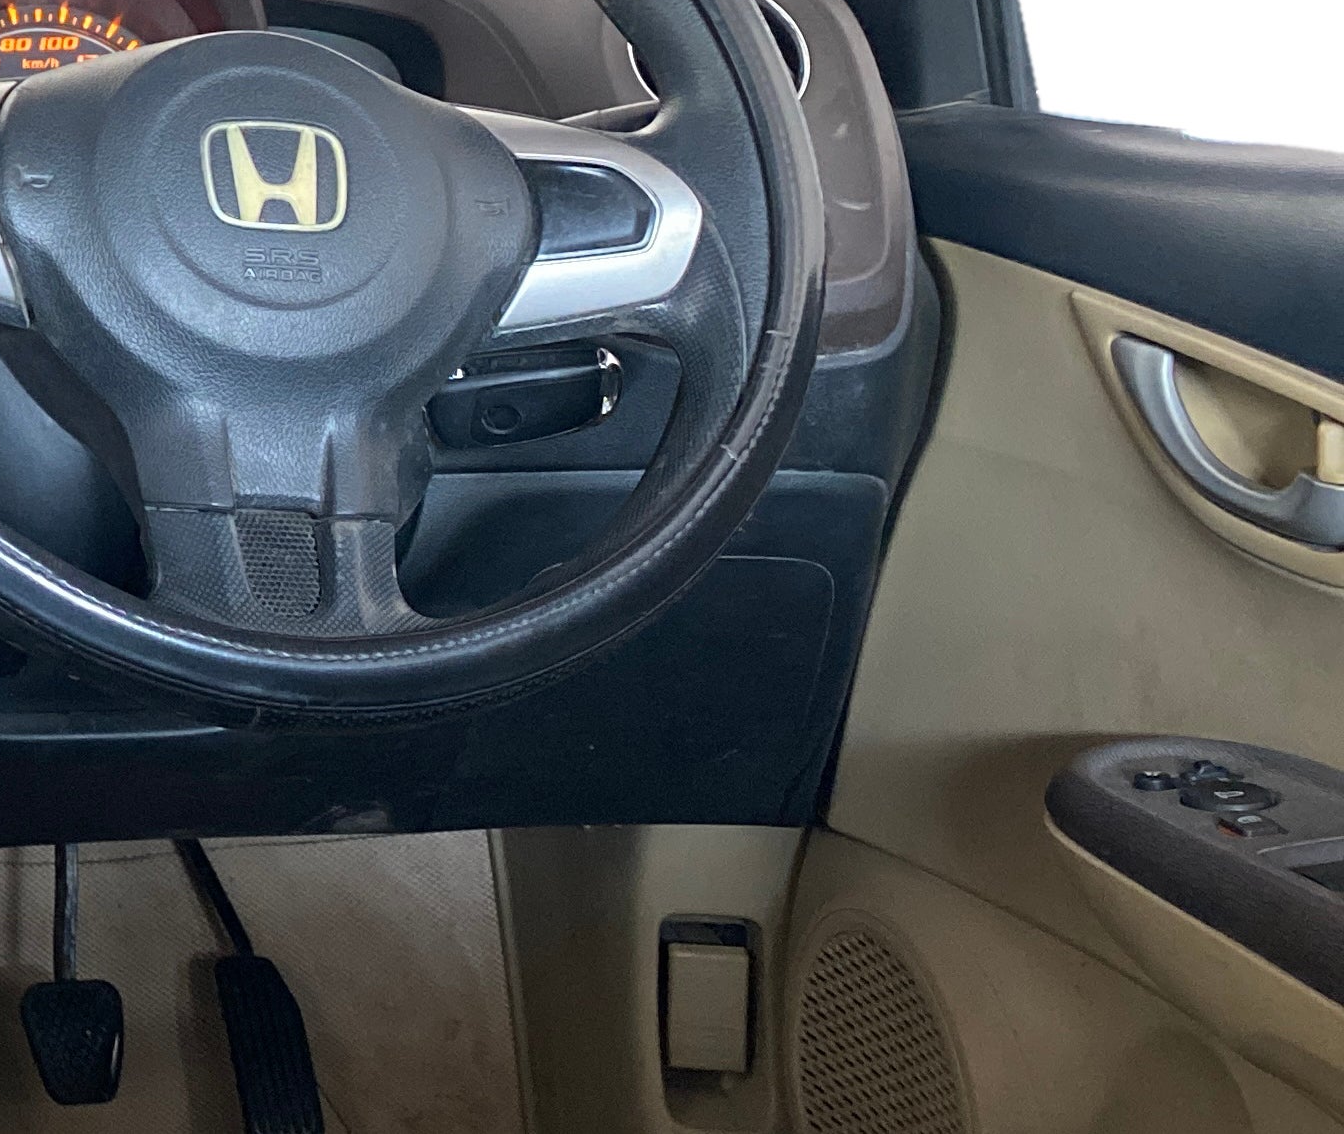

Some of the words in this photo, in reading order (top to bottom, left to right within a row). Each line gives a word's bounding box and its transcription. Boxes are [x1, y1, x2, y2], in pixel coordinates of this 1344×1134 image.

[0, 38, 32, 52] 80
[39, 37, 80, 51] 100
[22, 58, 60, 70] km/h
[243, 247, 320, 266] SRS
[242, 267, 322, 283] AIRBAG
